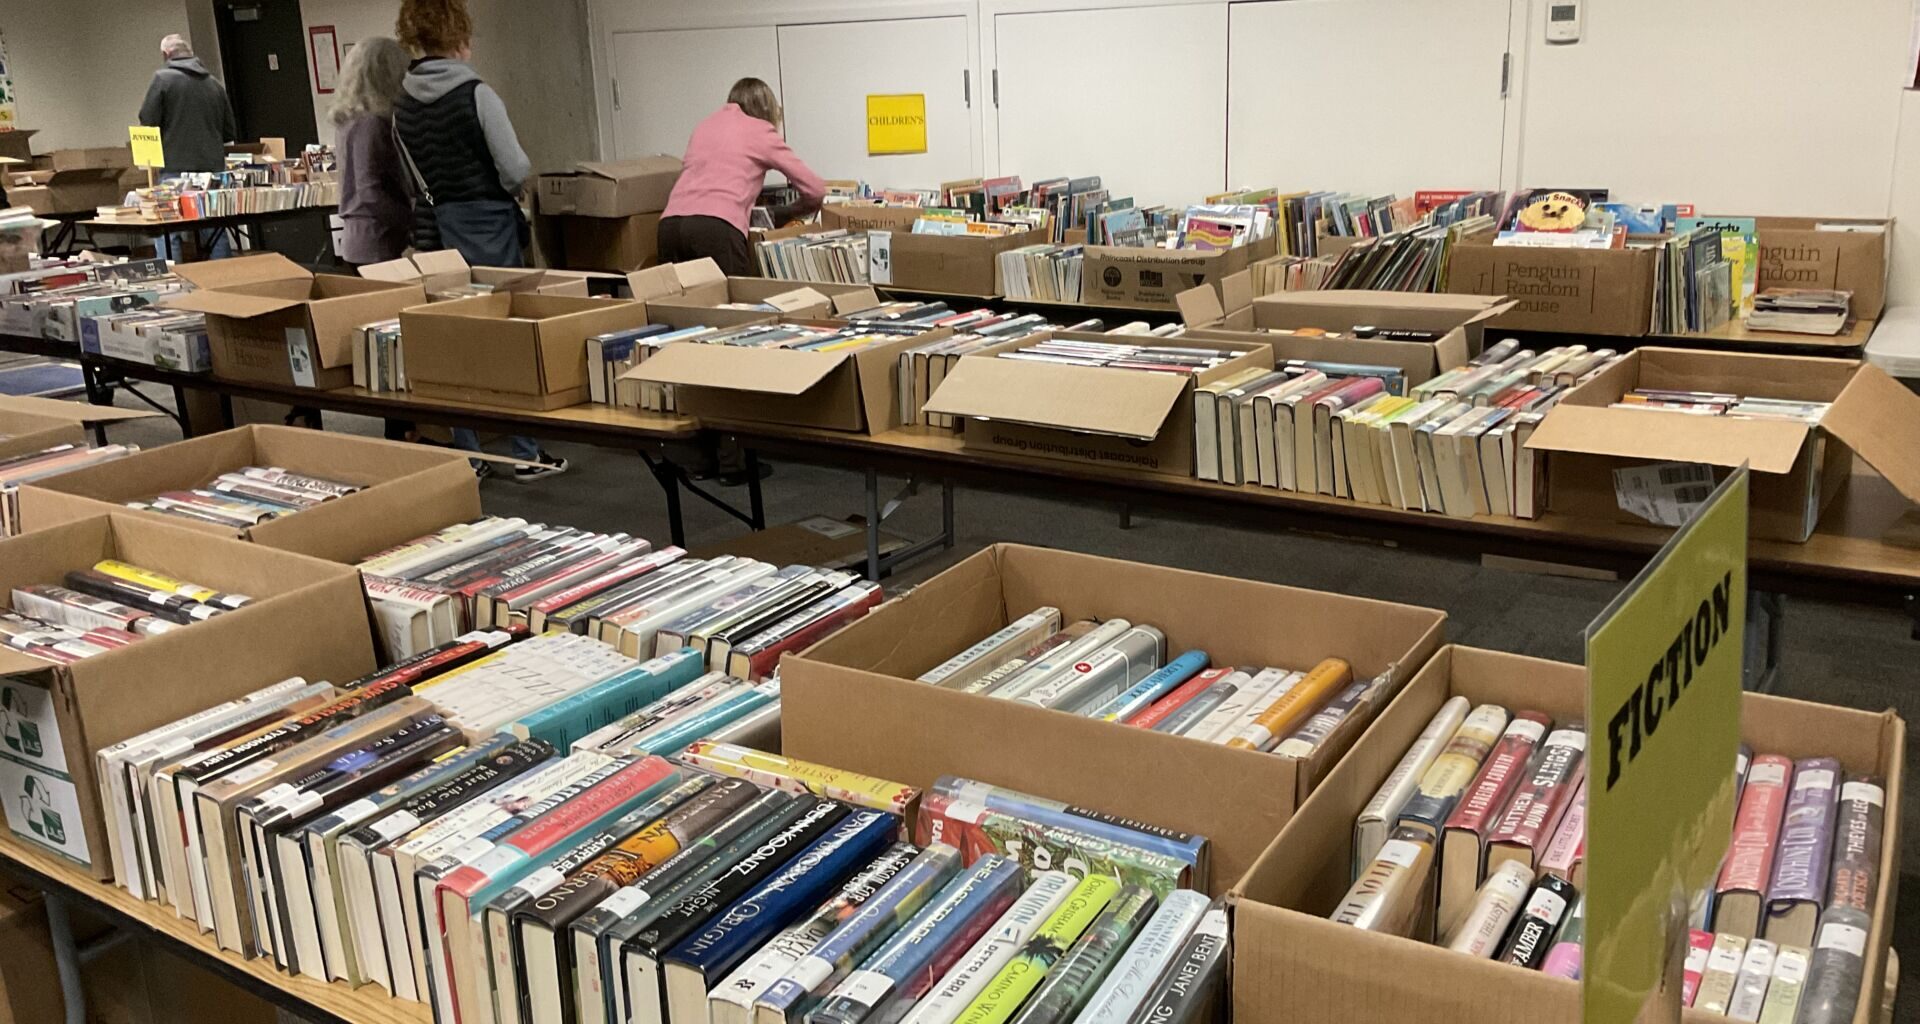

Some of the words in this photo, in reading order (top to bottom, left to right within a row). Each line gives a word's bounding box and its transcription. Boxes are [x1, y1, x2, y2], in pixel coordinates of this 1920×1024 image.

[869, 115, 924, 126] CHILDREN'S
[1136, 255, 1180, 265] Distribution
[1761, 243, 1820, 262] nguin
[1506, 262, 1580, 282] Penguin
[1761, 264, 1818, 282] ndom
[1506, 280, 1580, 297] Random
[992, 436, 1028, 450] Group
[1029, 441, 1097, 460] Distribution
[362, 678, 398, 700] CLIVE
[1606, 570, 1732, 793] FICTION
[300, 694, 360, 727] CUSSLER
[233, 725, 287, 755] TYPHOON
[336, 733, 395, 768] Serch
[201, 748, 233, 768] FURY
[1533, 743, 1575, 787] SLINGS
[464, 766, 498, 788] What
[1471, 780, 1497, 809] FOREIGN
[1489, 753, 1515, 783] COUNTRY
[410, 798, 436, 817] Bod
[437, 783, 463, 803] the
[528, 786, 570, 819] STATION
[557, 797, 586, 818] LOST
[791, 802, 838, 833] DEAN
[835, 810, 877, 842] DAN
[1071, 805, 1097, 818] time
[1498, 793, 1531, 834] MATTHEW
[1525, 804, 1548, 827] DUNN
[1562, 811, 1582, 833] SECRET
[520, 814, 559, 841] PLOTS
[1044, 823, 1105, 855] COMPANY
[1118, 817, 1172, 837] shortcut
[1554, 830, 1572, 850] LITTLE
[1845, 818, 1868, 853] THIEVES
[570, 831, 617, 864] LARRY
[736, 829, 795, 875] KOONTZ
[536, 846, 637, 910] INFERNO
[869, 852, 910, 887] SEASON
[972, 854, 1005, 882] THE
[1771, 846, 1813, 891] JOSEPHINE
[683, 880, 720, 916] NIGHT
[850, 881, 874, 904] FOR
[944, 875, 980, 907] LAST
[1010, 876, 1065, 925] OBLIVION
[1077, 873, 1106, 901] JOHN
[1358, 877, 1384, 902] NO
[703, 899, 717, 912] THE
[1044, 894, 1088, 936] GRISHAM
[689, 899, 761, 955] ORIGIN
[904, 903, 953, 945] TRADE
[1478, 917, 1499, 939] THE
[1513, 922, 1545, 961] AMBER
[1167, 957, 1204, 997] JANET
[1190, 932, 1219, 964] BENT
[981, 956, 1032, 1006] CAMINO
